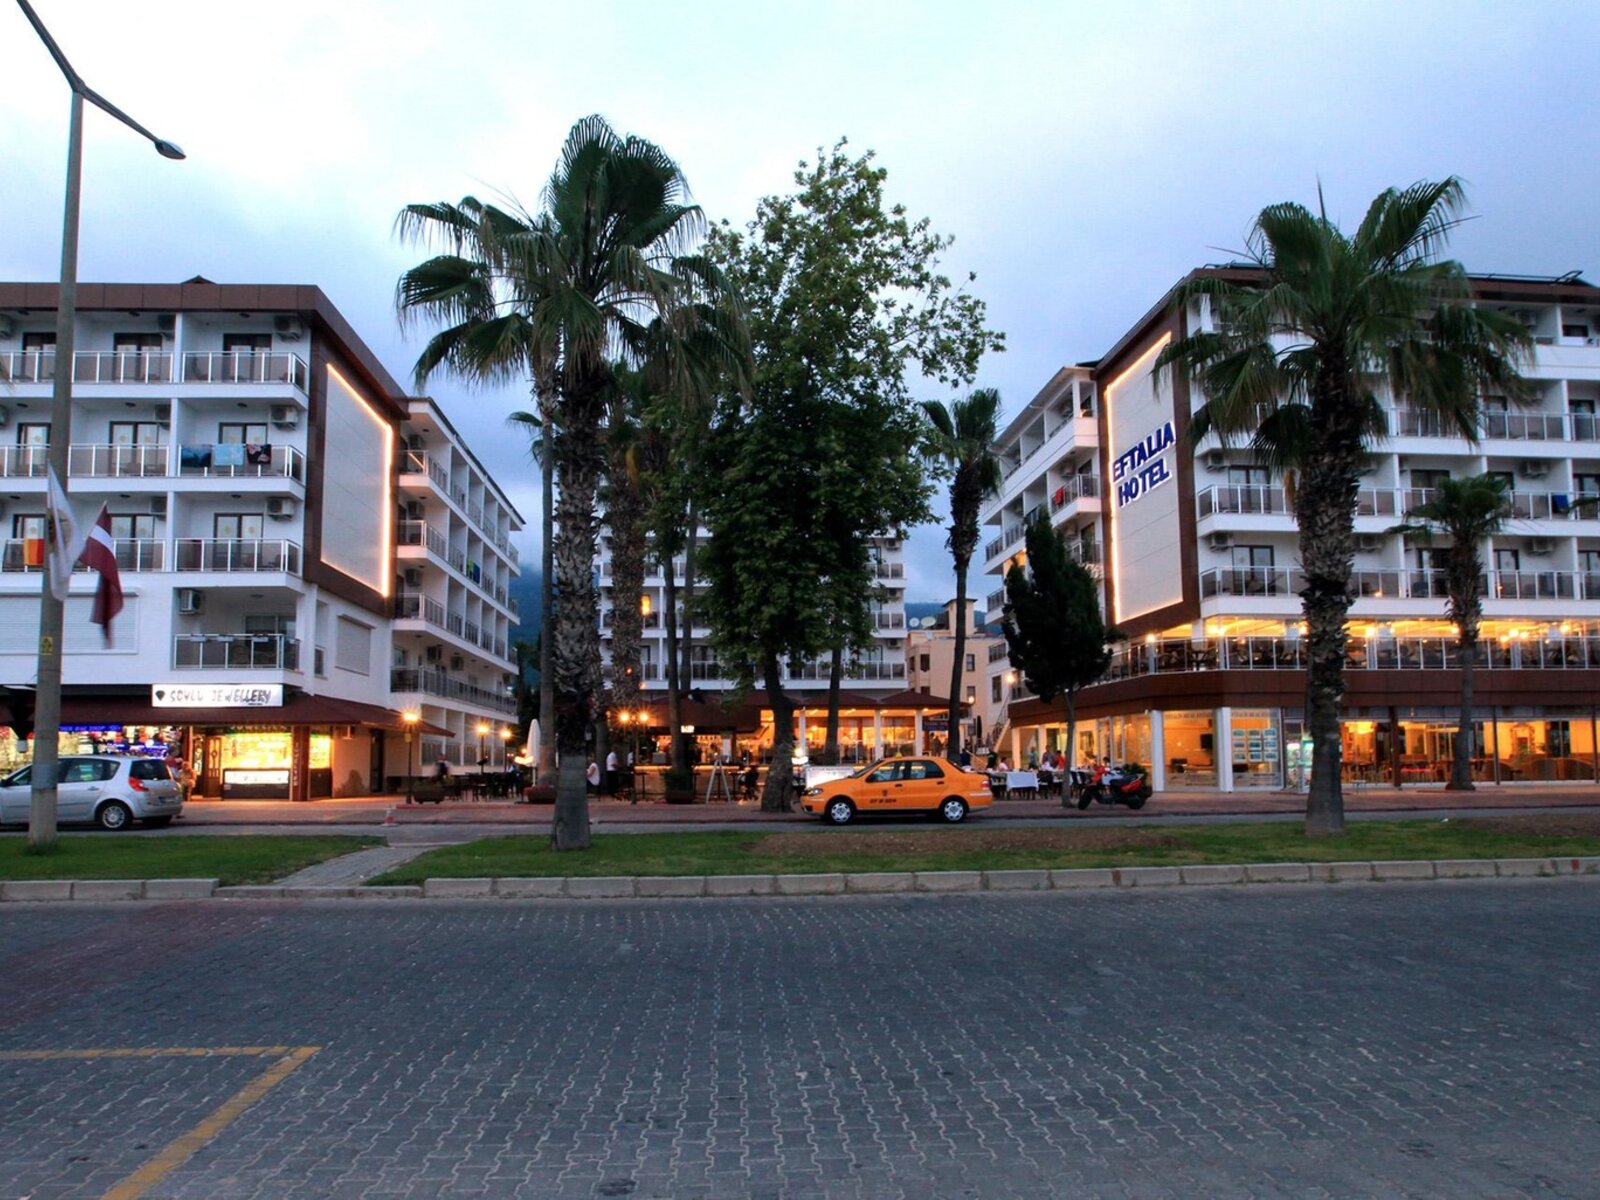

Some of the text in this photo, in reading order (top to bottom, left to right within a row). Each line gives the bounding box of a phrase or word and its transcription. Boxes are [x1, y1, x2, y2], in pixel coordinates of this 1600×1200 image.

[1113, 421, 1175, 482] EFTALIA
[1118, 458, 1171, 507] HOTEL
[211, 688, 272, 704] JEWELLERY
